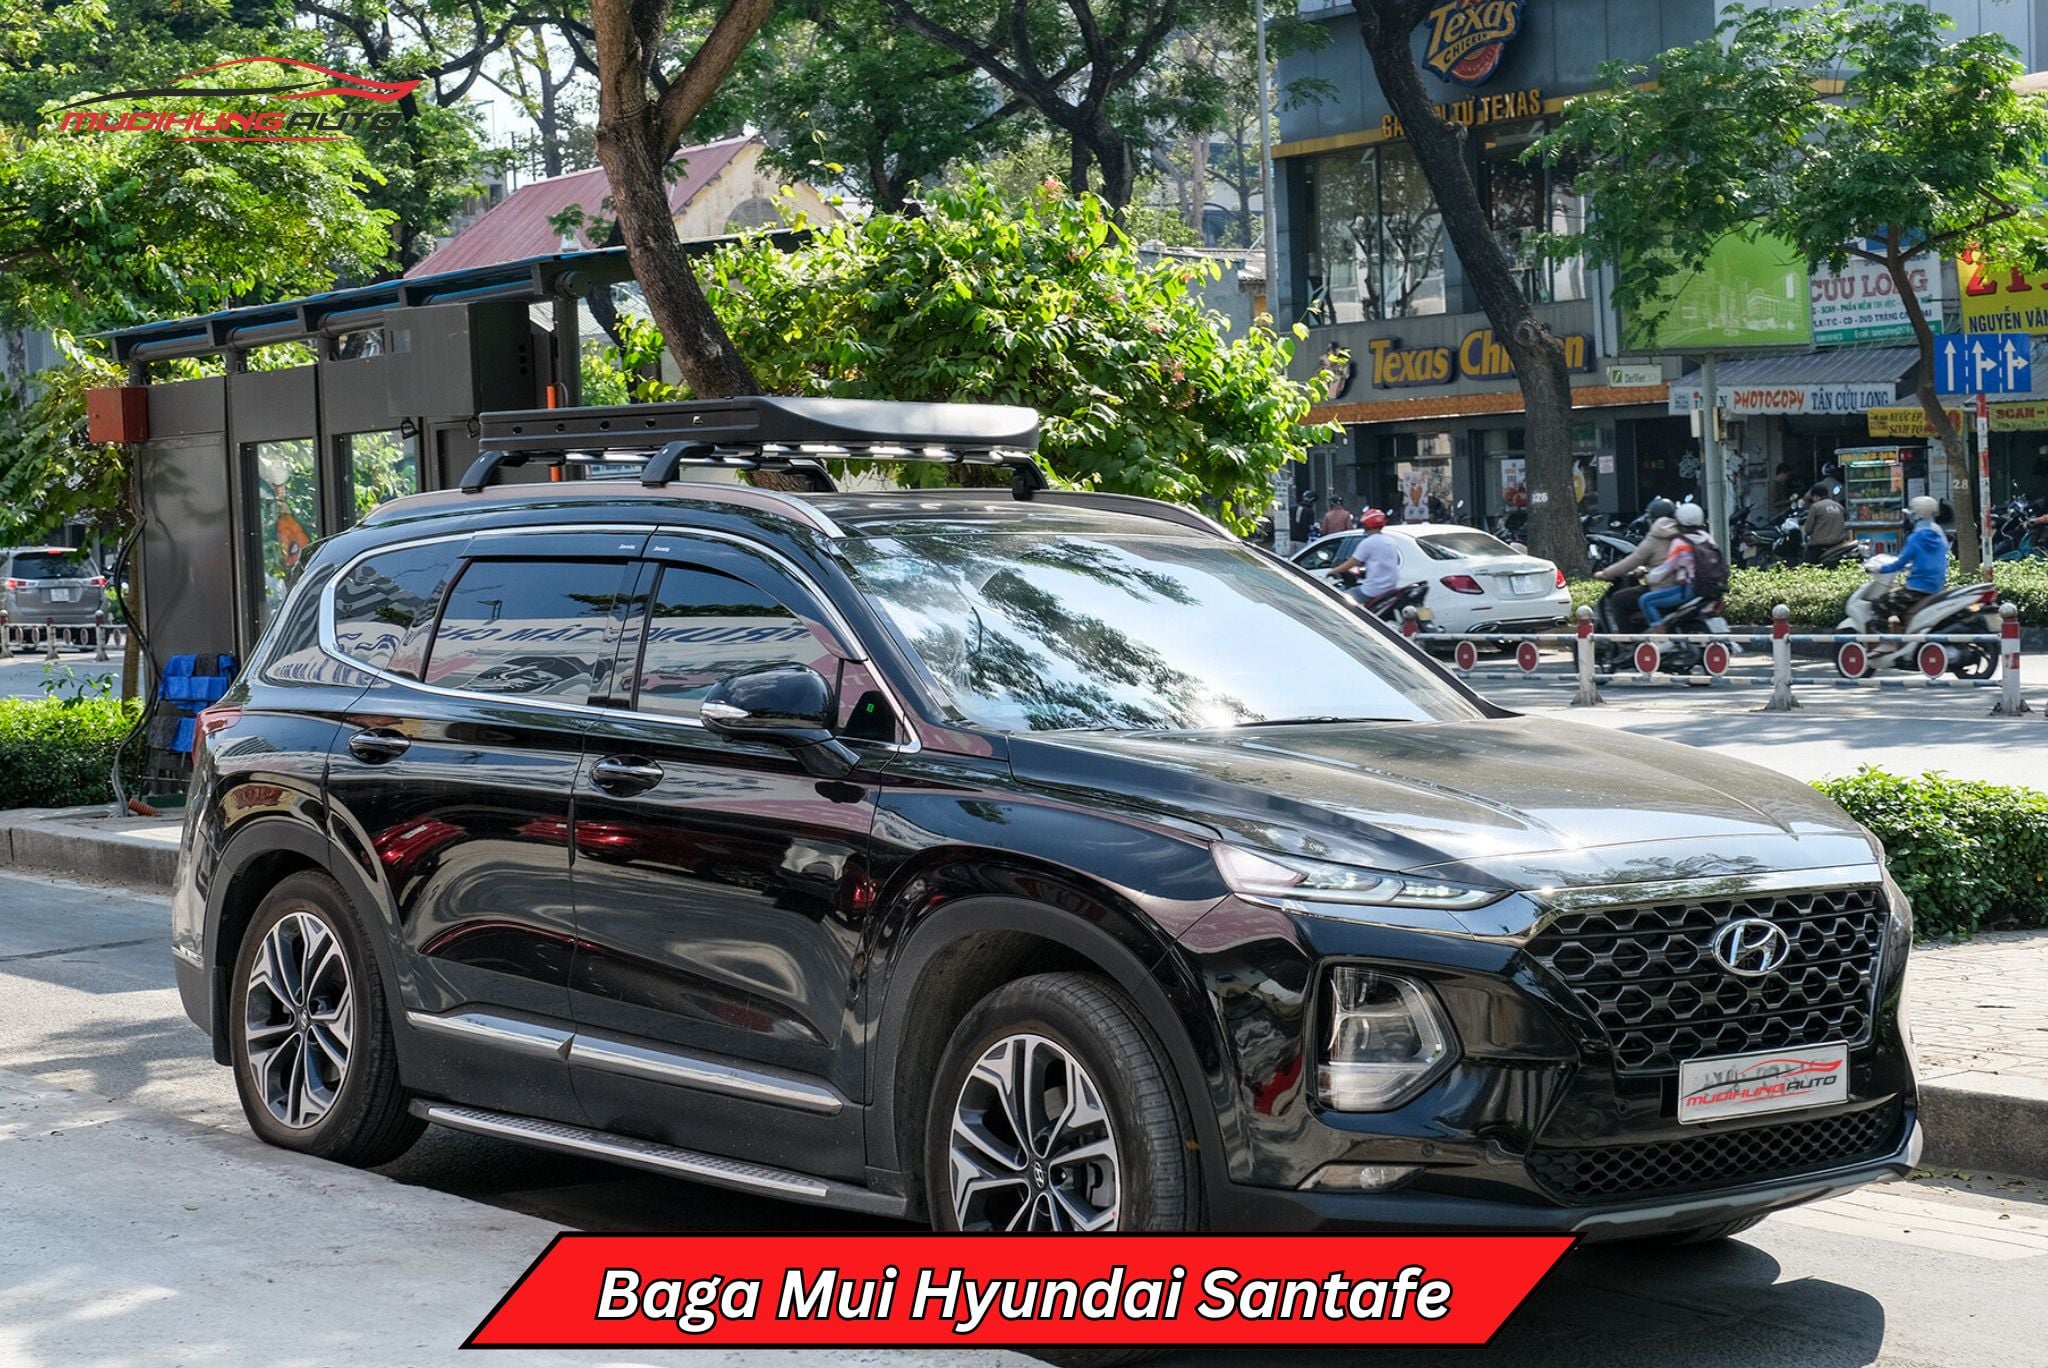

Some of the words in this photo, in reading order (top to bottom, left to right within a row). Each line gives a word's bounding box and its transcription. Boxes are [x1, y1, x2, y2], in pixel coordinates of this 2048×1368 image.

[1427, 0, 1518, 58] Texas
[1443, 32, 1488, 64] CHICKEN
[1480, 88, 1542, 123] TEXAS
[1861, 268, 1928, 298] LOG
[1968, 305, 2022, 334] NGUYỄN
[1370, 338, 1450, 385] Texas
[1459, 329, 1584, 376] Chin
[1733, 389, 1805, 411] PHOTOCOPY
[1811, 387, 1833, 411] TÂN
[1861, 390, 1889, 409] LONG
